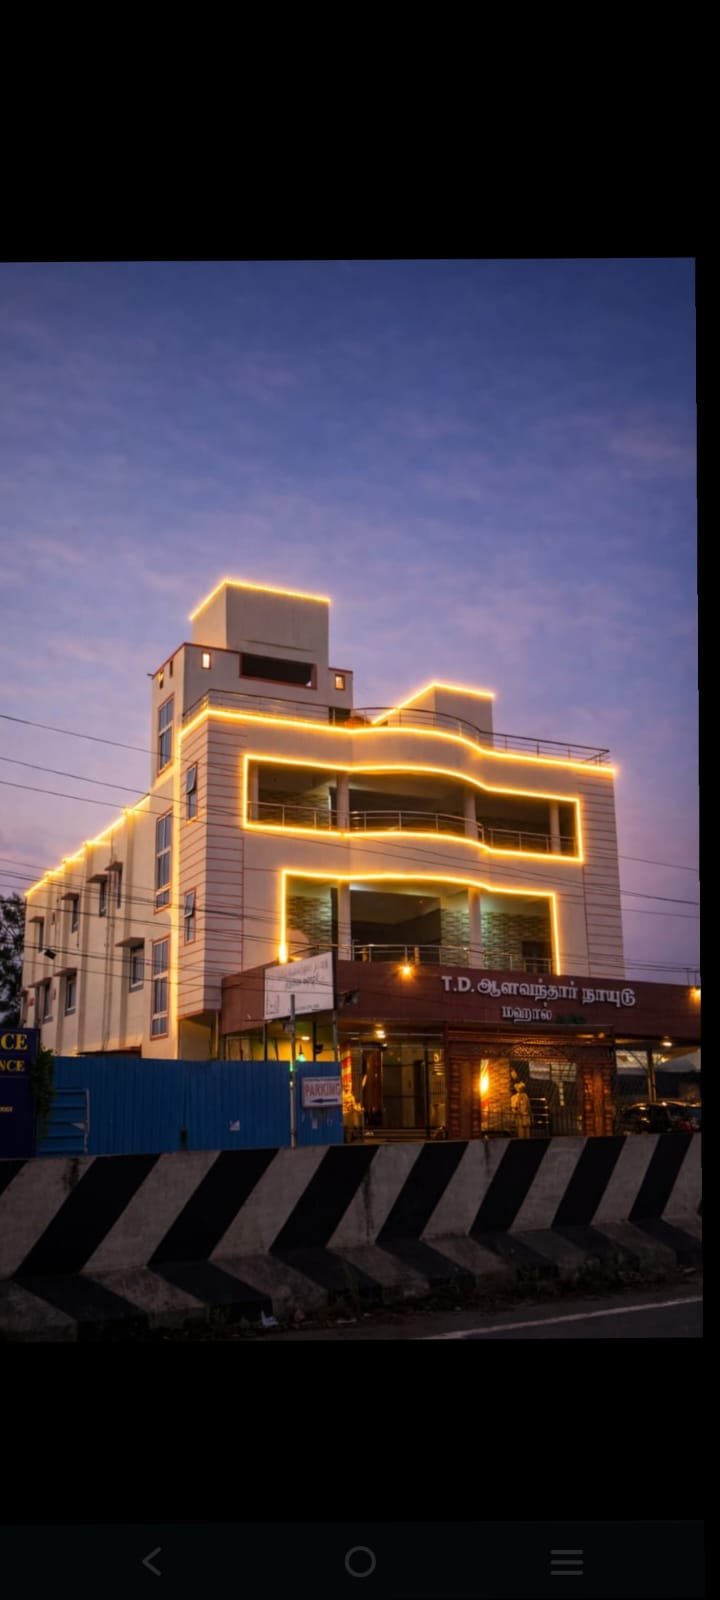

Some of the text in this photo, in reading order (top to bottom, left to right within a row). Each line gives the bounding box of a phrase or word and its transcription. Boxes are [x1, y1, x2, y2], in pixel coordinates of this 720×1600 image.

[441, 975, 636, 1007] T.D. ஆளவந்தார் நாயுடு
[502, 1002, 553, 1022] மஹால்
[304, 1083, 341, 1097] PARKING
